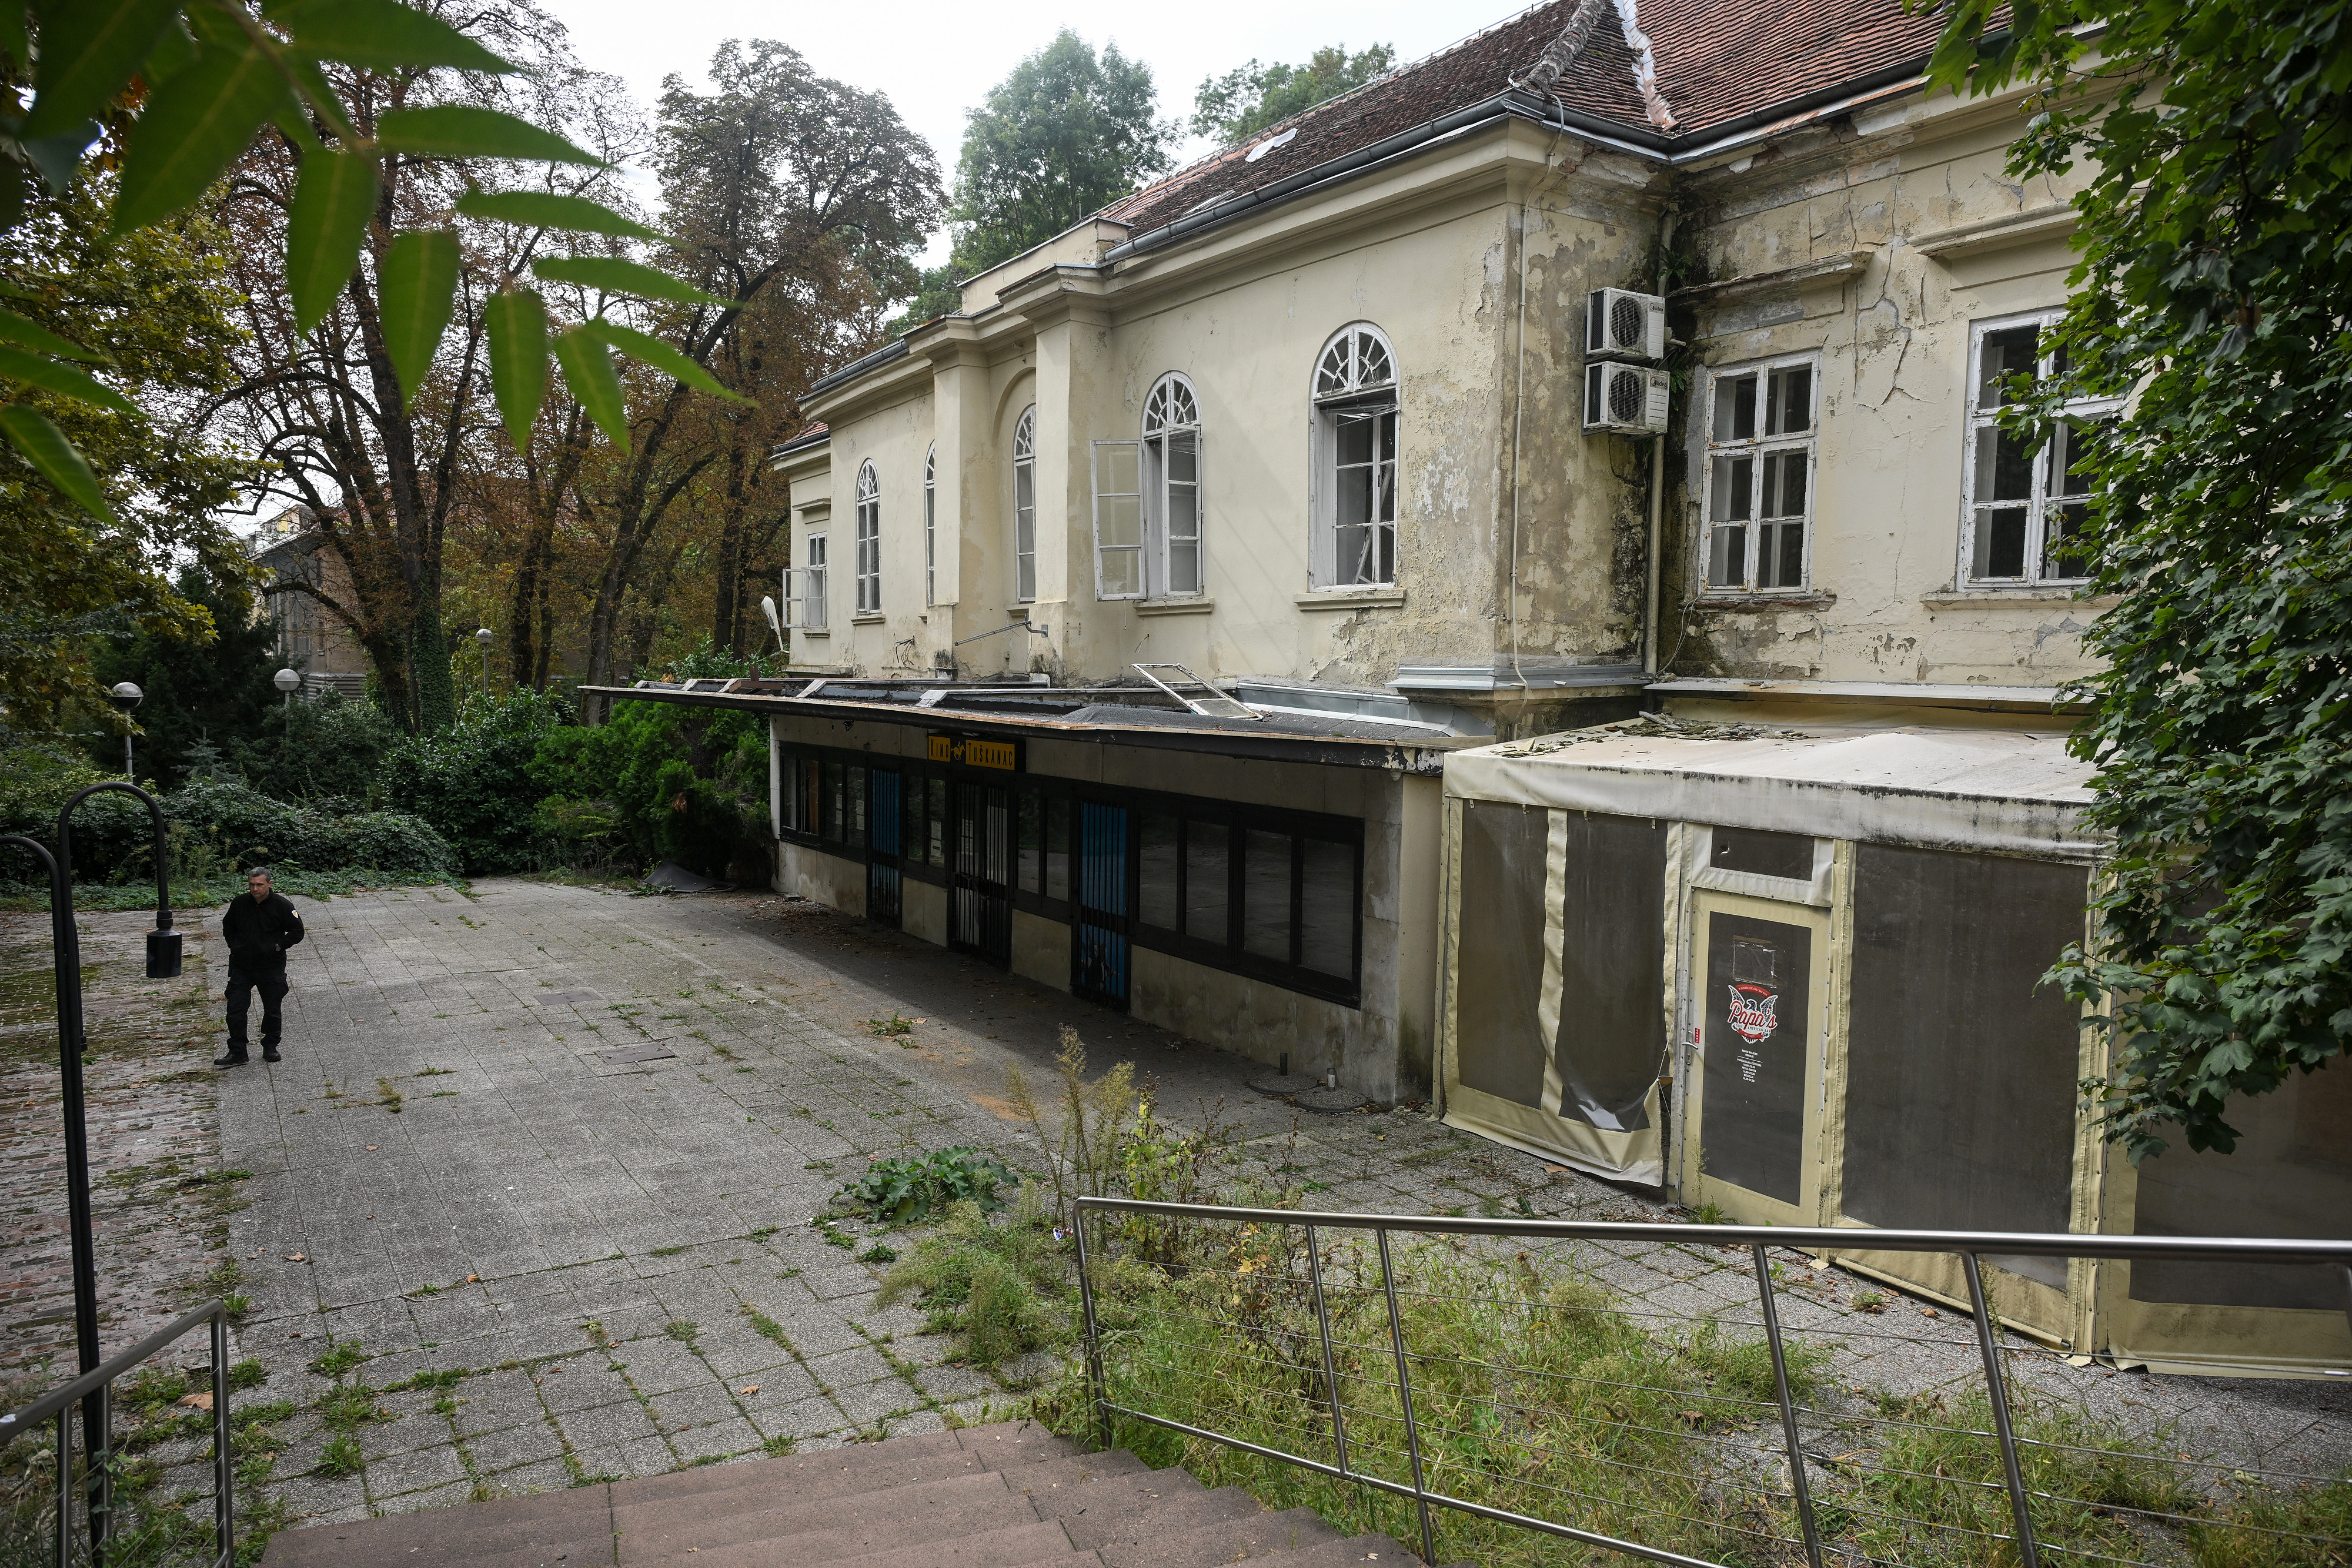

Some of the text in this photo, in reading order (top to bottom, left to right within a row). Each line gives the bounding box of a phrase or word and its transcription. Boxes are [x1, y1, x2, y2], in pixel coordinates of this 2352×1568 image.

[1649, 303, 1663, 312] Midea
[1651, 377, 1667, 387] Midea
[931, 739, 1013, 766] KINO TUŠKANAC
[1729, 1001, 1777, 1029] Papa's
